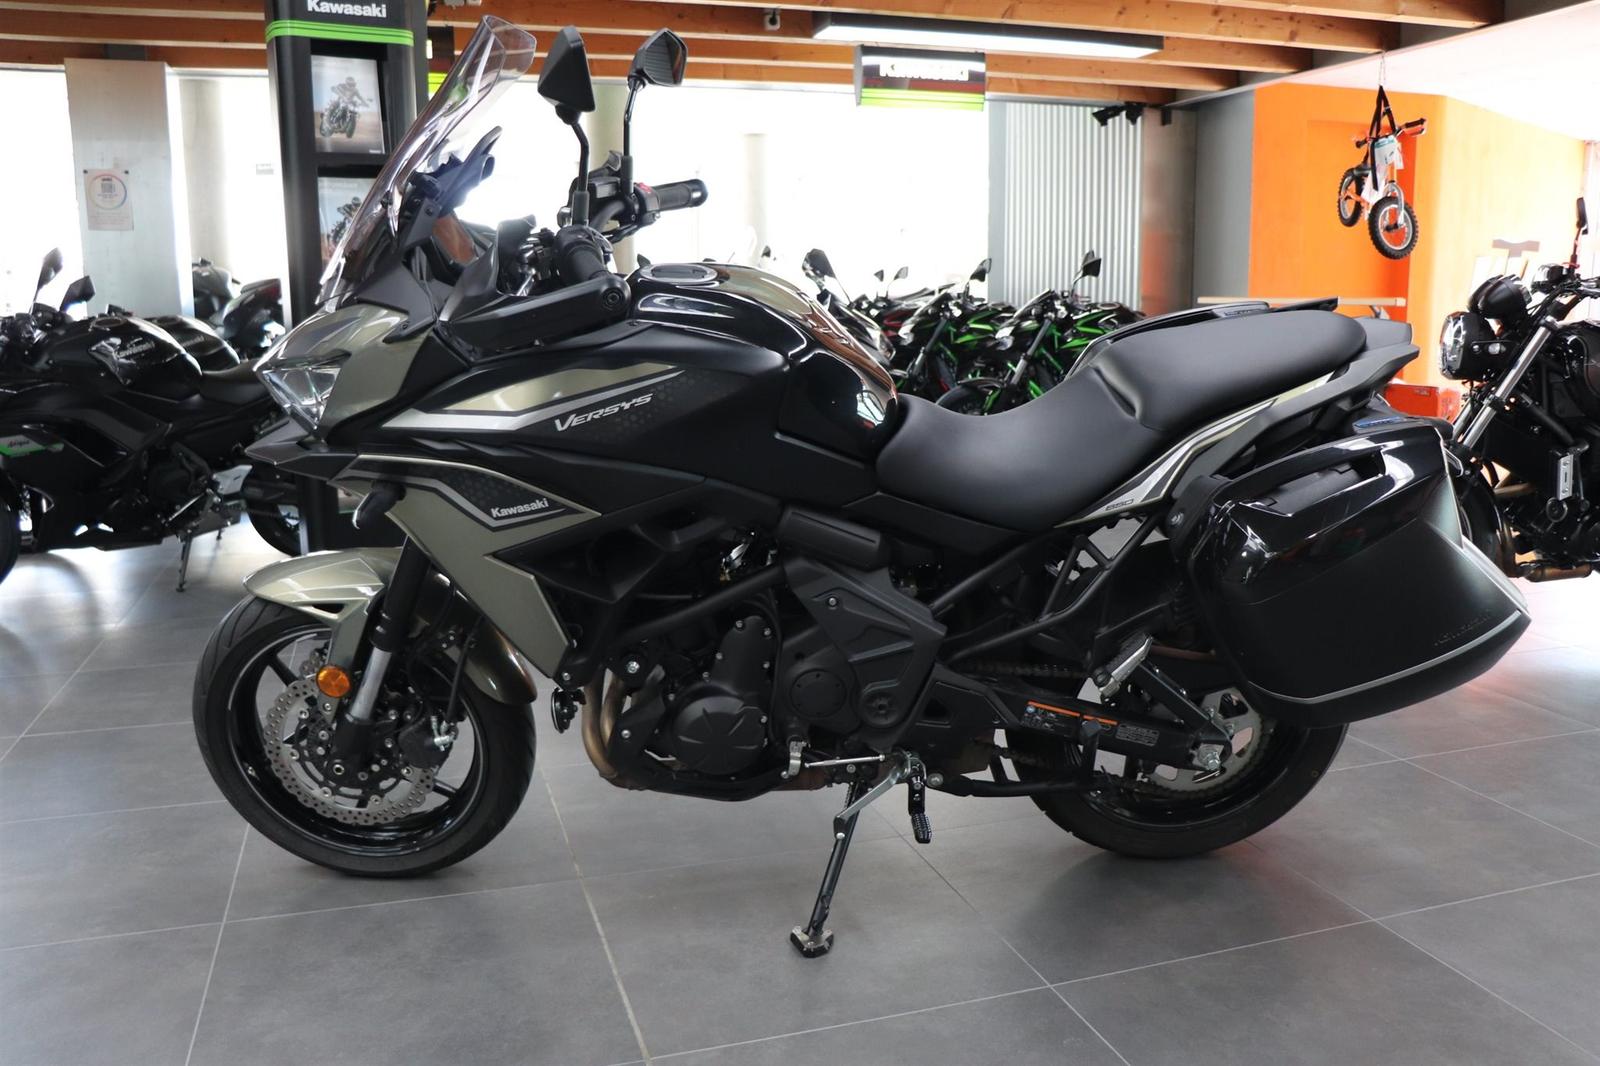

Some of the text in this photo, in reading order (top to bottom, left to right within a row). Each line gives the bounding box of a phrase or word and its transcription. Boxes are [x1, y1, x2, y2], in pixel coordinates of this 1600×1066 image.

[307, 0, 387, 18] Kawasaki
[554, 393, 653, 432] VERSYS
[490, 497, 549, 518] Kawasaki
